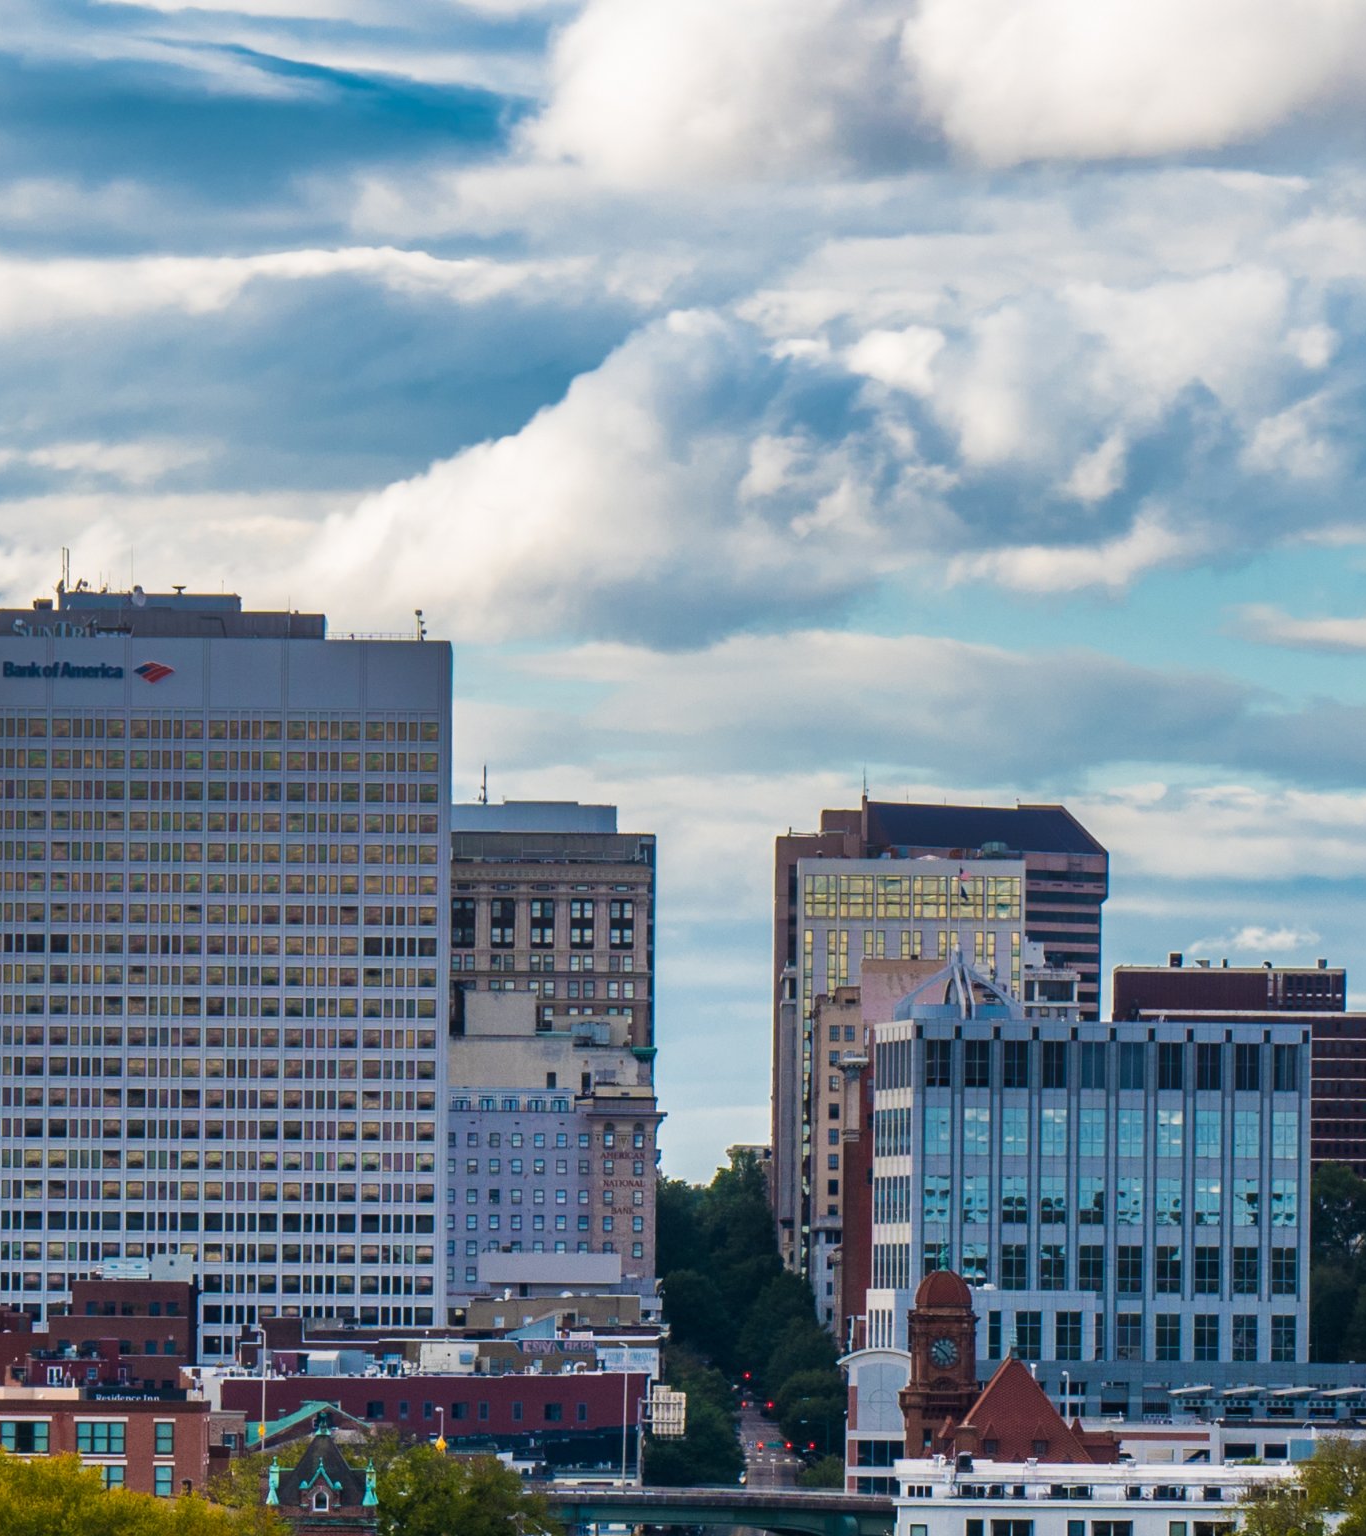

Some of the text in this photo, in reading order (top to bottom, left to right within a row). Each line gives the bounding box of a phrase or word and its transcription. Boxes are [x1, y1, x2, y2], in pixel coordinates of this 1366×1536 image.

[2, 661, 124, 679] Bank of America
[600, 1151, 646, 1160] AMERICAN
[602, 1179, 645, 1188] NATIONAL
[611, 1206, 636, 1215] BANK
[95, 1393, 142, 1401] Residence
